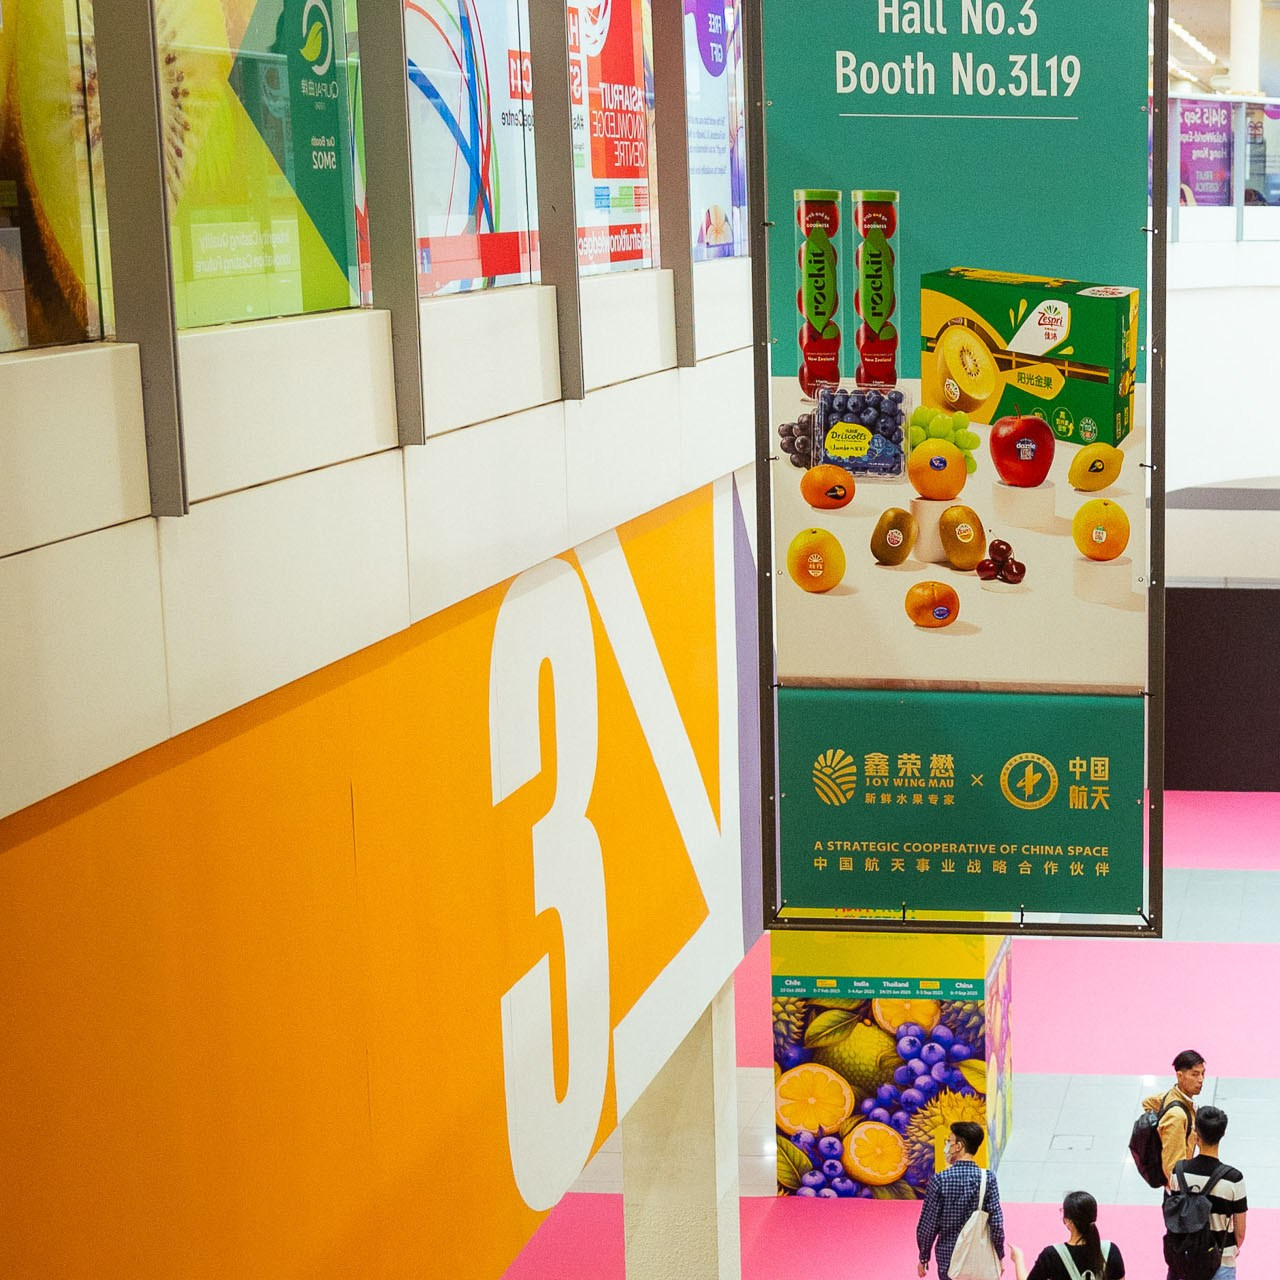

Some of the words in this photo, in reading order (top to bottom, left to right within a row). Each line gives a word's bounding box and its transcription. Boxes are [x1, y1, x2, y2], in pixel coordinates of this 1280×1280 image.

[835, 50, 935, 95] Booth
[951, 52, 1081, 97] No.3L19
[807, 248, 825, 317] rockit
[864, 250, 882, 318] rockit
[1037, 311, 1063, 327] Zespri
[864, 753, 955, 778] 鑫荣懋
[1069, 756, 1110, 782] 中国
[866, 778, 890, 787] JOY
[893, 778, 926, 788] WING
[928, 779, 954, 788] MAU
[864, 793, 955, 806] 新鲜水果专家
[1069, 785, 1110, 811] 航天
[814, 841, 823, 851] A
[827, 841, 900, 852] STRATEGIC
[903, 842, 996, 854] COOPERATIVE
[1000, 844, 1017, 855] OF
[1021, 844, 1063, 855] CHINA
[1067, 845, 1109, 857] SPACE
[813, 856, 1110, 877] 中国航天事业战略合作伙伴
[489, 556, 611, 1212] 3
